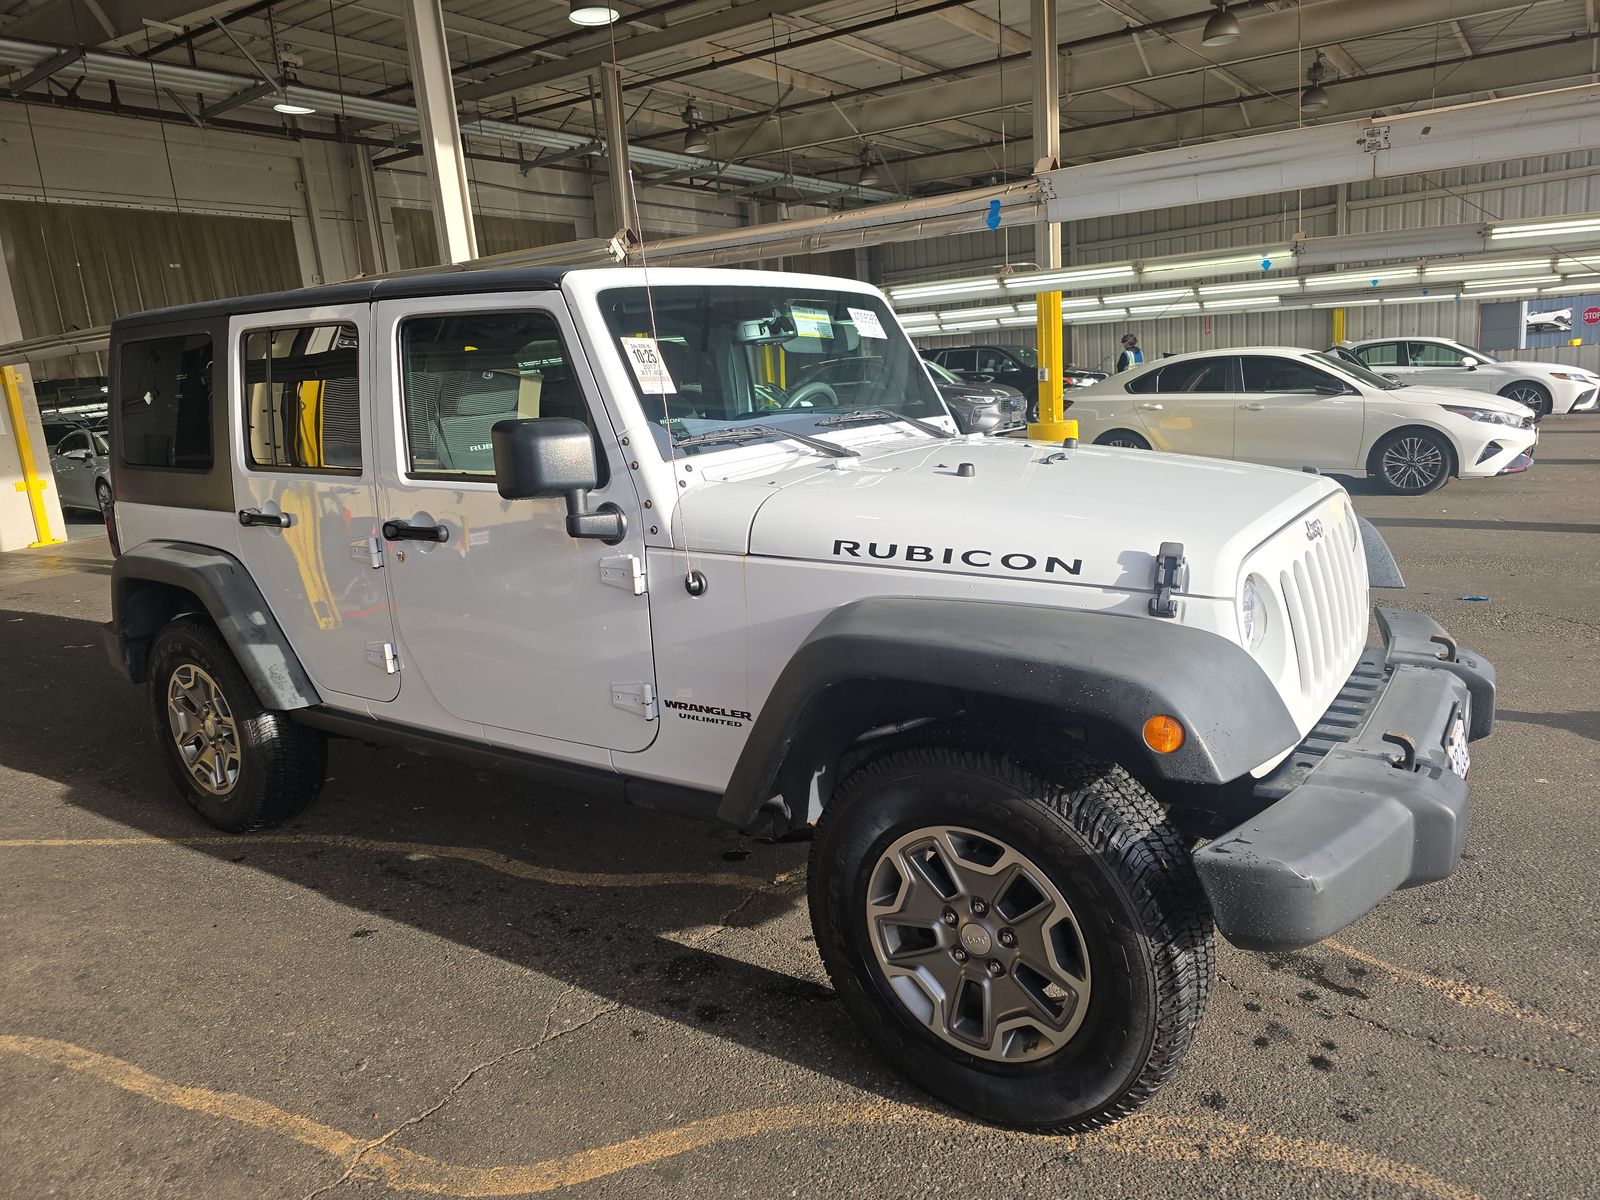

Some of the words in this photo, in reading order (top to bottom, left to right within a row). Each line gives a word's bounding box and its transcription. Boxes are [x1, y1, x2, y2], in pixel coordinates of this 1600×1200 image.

[633, 349, 657, 363] 10:25
[832, 540, 1082, 575] RUBICON
[664, 700, 753, 721] WRANGLER
[679, 713, 742, 727] UNLIMITED
